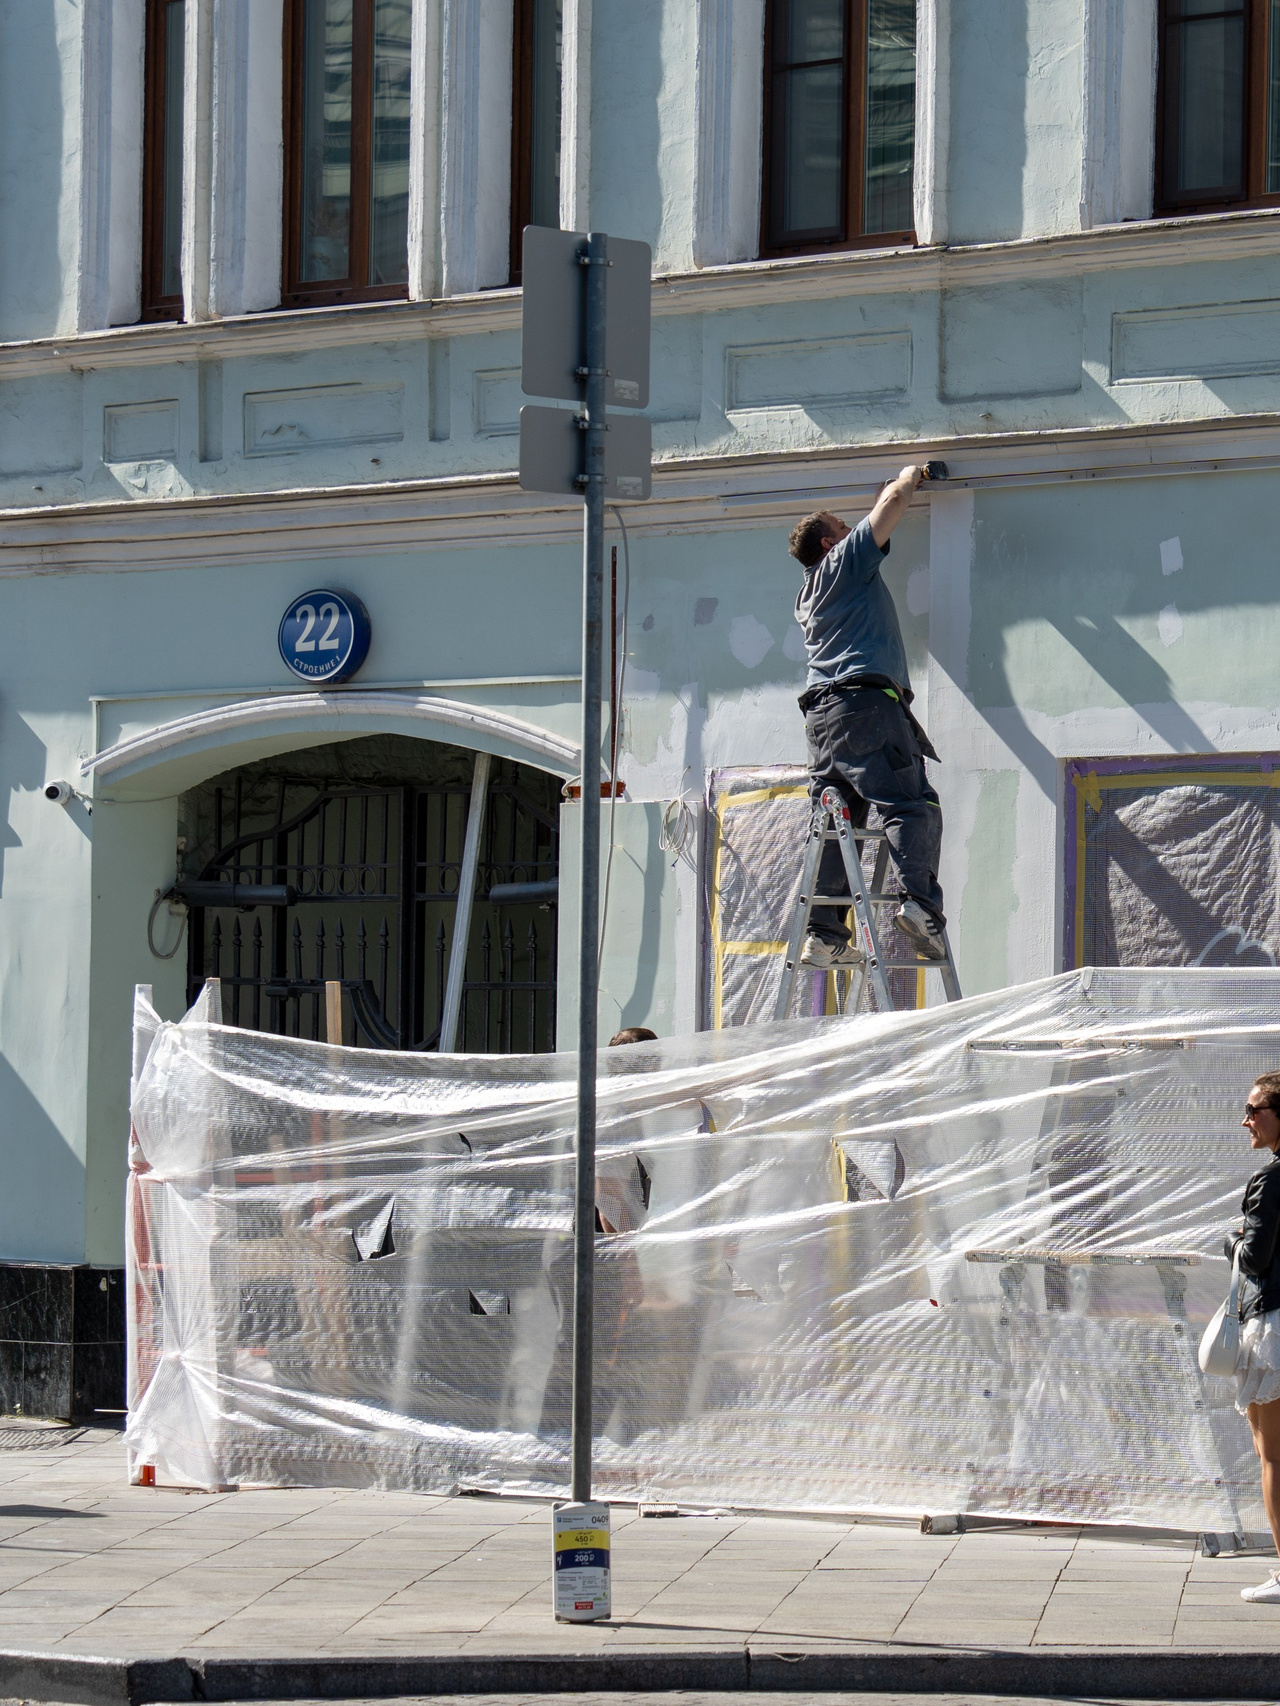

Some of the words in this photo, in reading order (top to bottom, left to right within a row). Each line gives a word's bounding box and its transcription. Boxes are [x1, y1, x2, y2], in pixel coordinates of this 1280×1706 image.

[295, 602, 340, 652] 22
[294, 658, 335, 674] СТРОЕНИЕ
[592, 1515, 608, 1524] 0409
